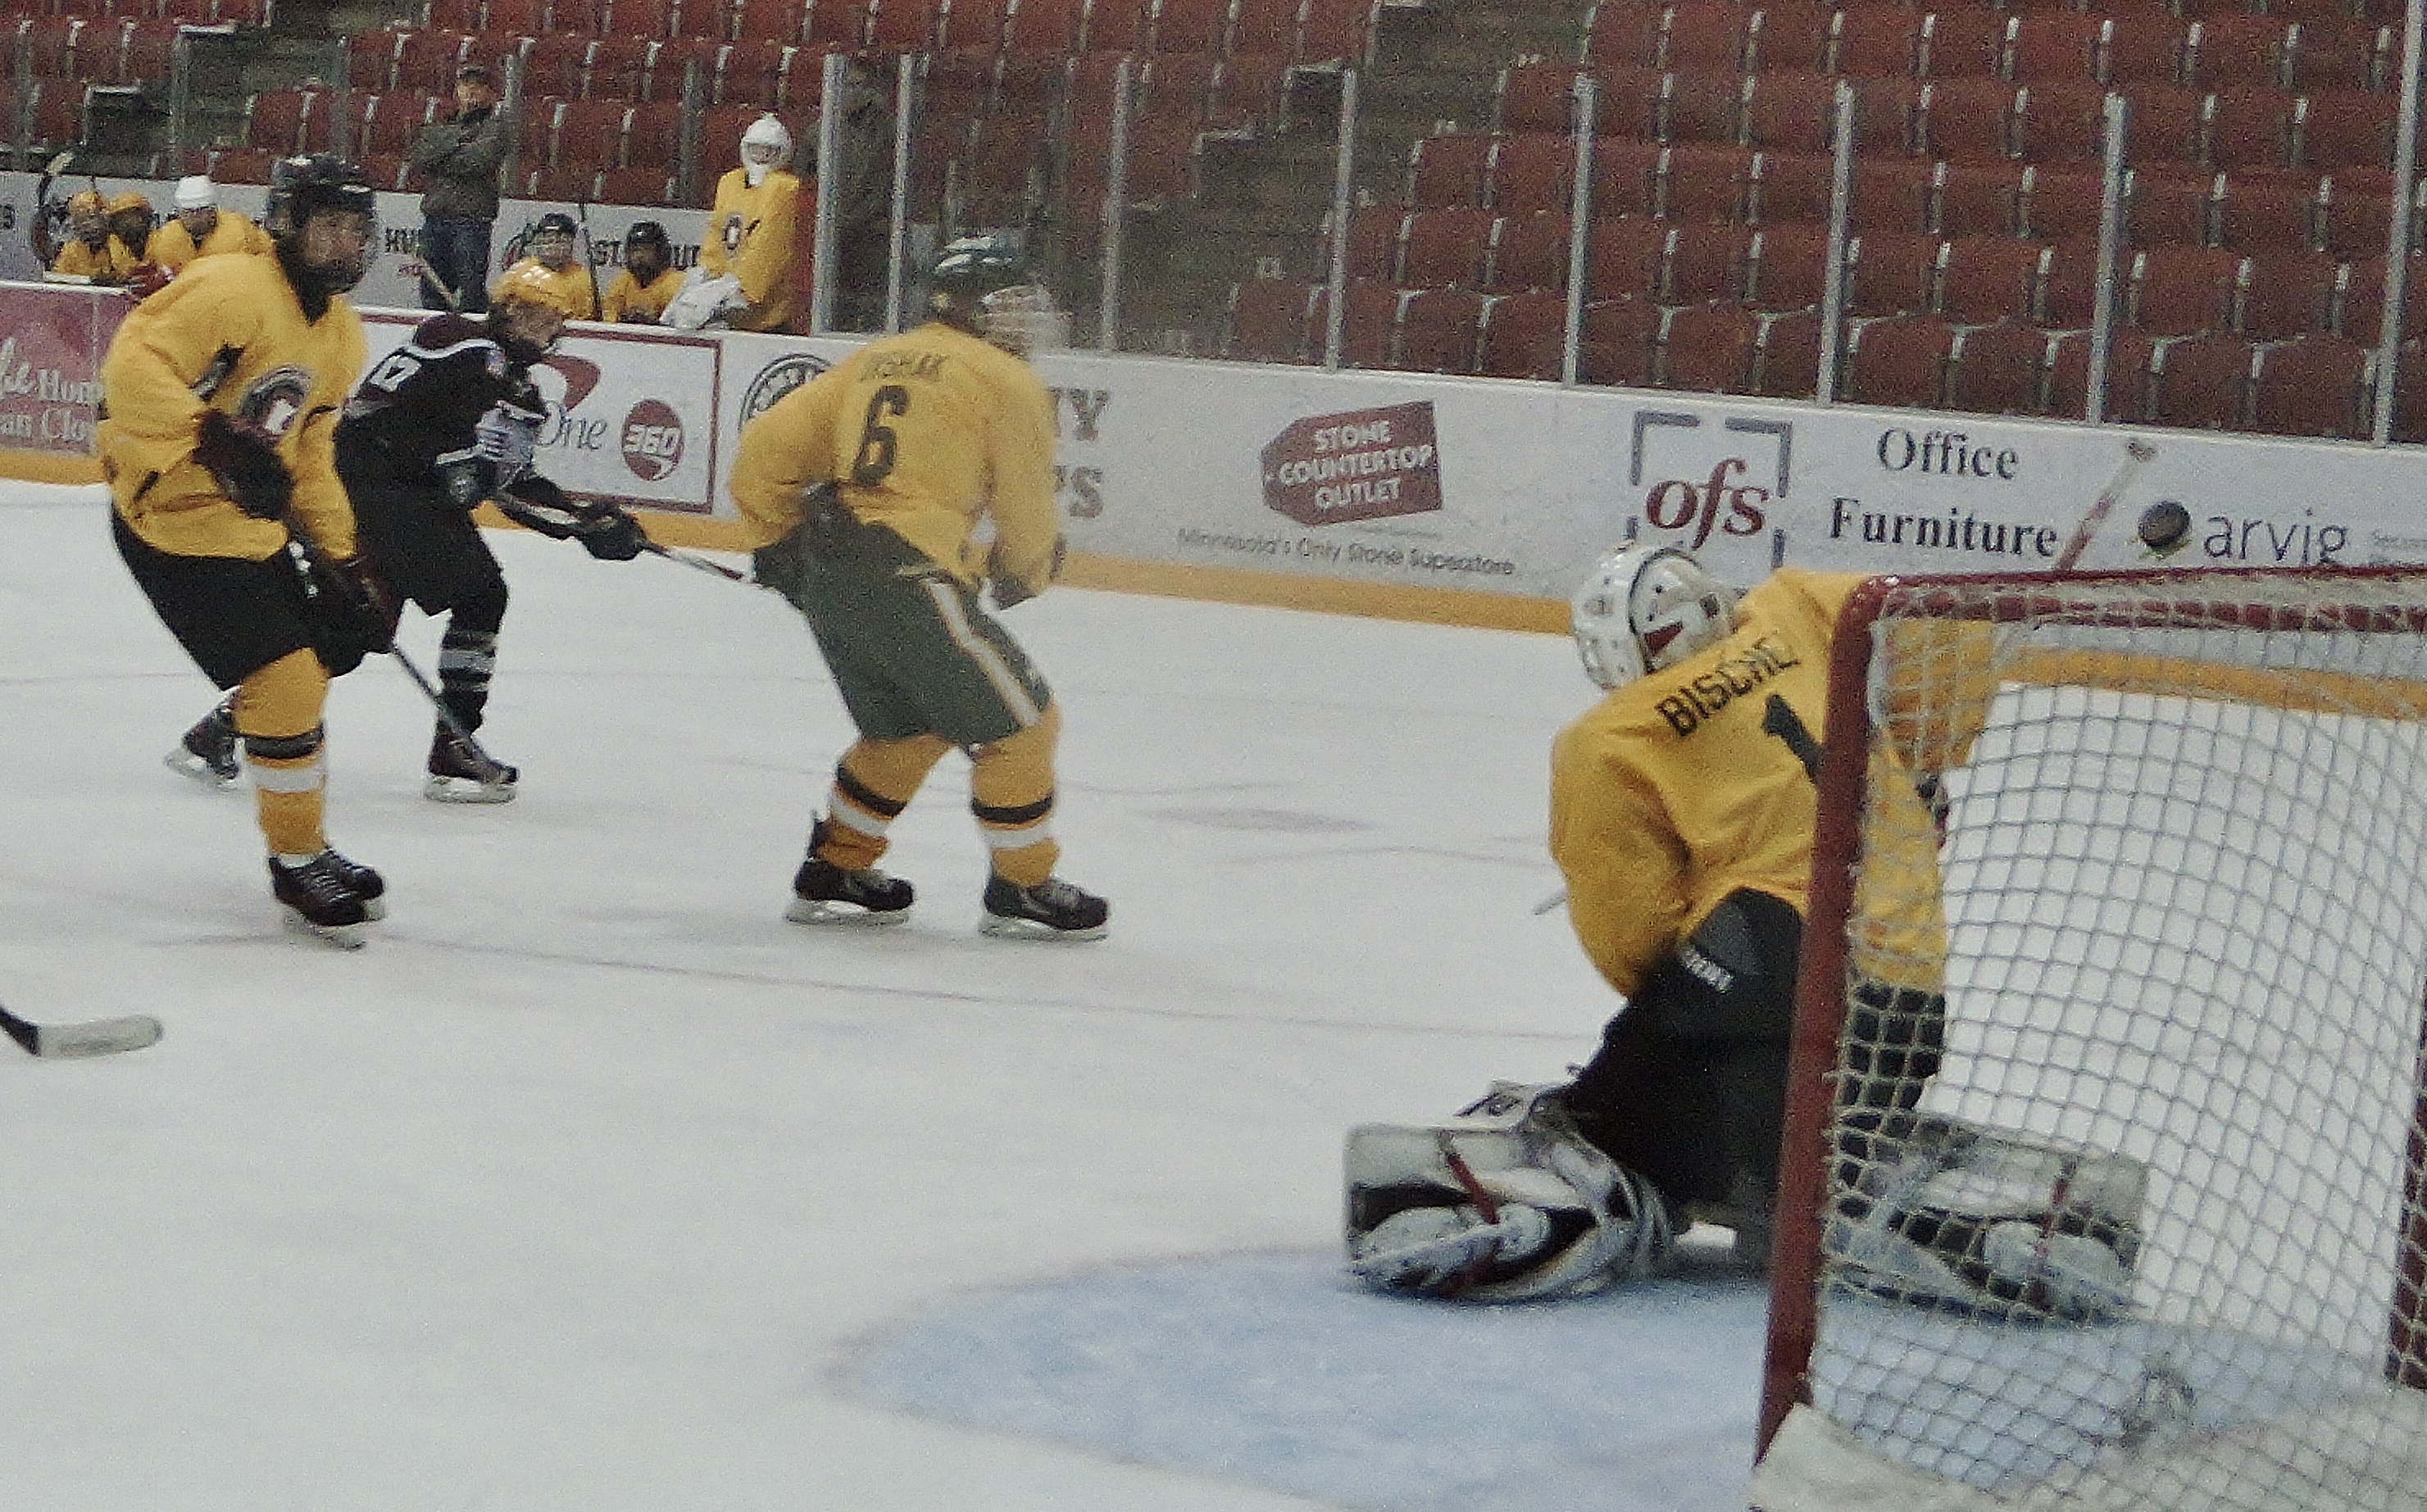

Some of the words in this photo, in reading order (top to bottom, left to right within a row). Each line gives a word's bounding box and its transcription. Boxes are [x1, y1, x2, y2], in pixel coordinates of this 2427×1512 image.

[623, 423, 682, 457] 360
[851, 384, 910, 488] 6
[1314, 420, 1393, 453] STONE
[1877, 427, 2021, 480] Office
[1279, 443, 1433, 487] COUNTERTOP
[1314, 478, 1402, 510] OUTLET
[1644, 456, 1769, 551] ofs
[1829, 496, 2058, 556] Furniture
[1297, 537, 1342, 563] Only
